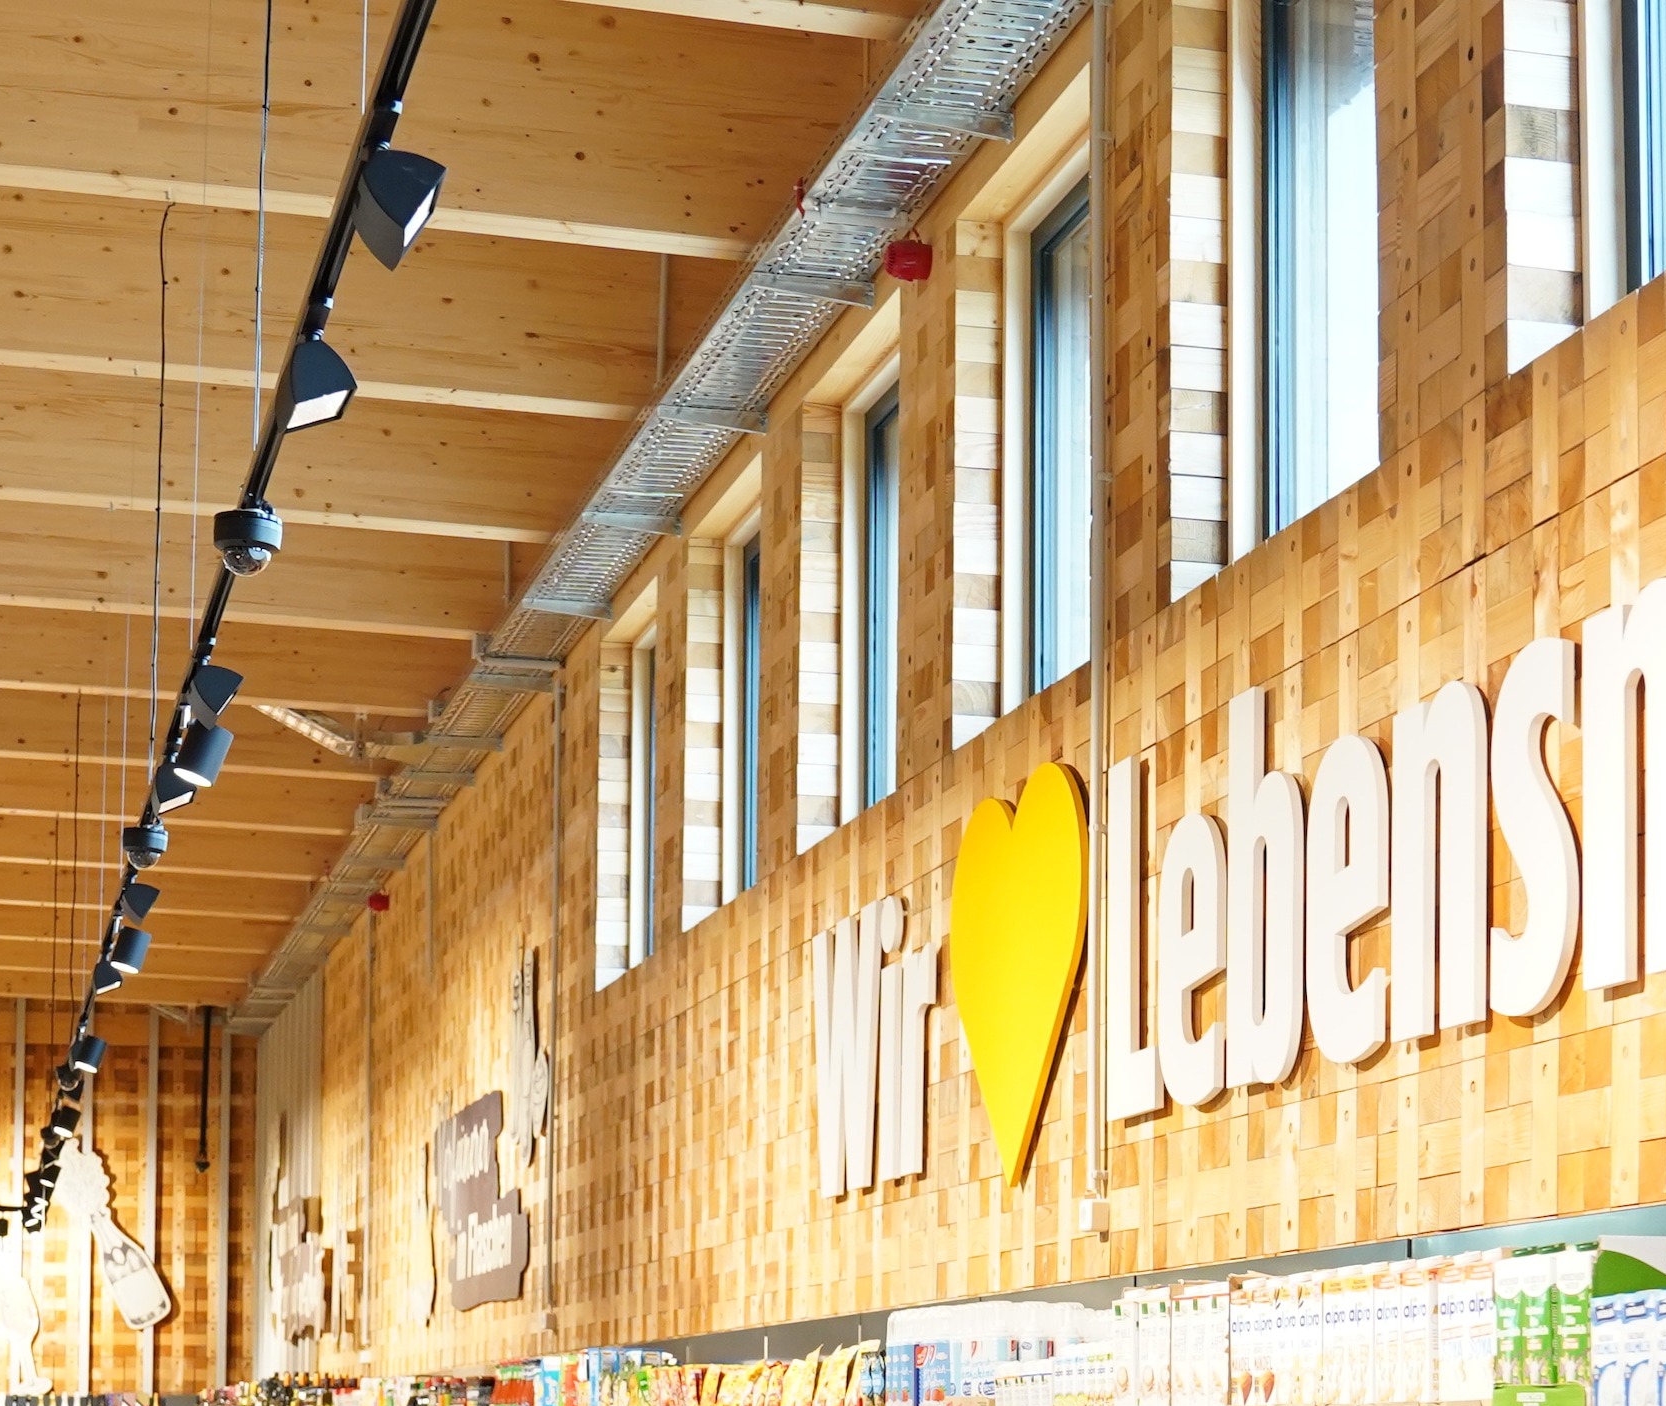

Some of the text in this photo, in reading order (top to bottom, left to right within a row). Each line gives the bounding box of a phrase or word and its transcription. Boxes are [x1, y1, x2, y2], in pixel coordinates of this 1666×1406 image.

[812, 895, 937, 1198] Wir
[1349, 1306, 1370, 1327] alpro
[1376, 1303, 1398, 1325] alpro
[1404, 1300, 1426, 1322] alpro
[1440, 1297, 1464, 1320] alpro
[1468, 1294, 1494, 1317] alpro
[1300, 1310, 1320, 1330] alpro
[1325, 1308, 1345, 1328] alpro
